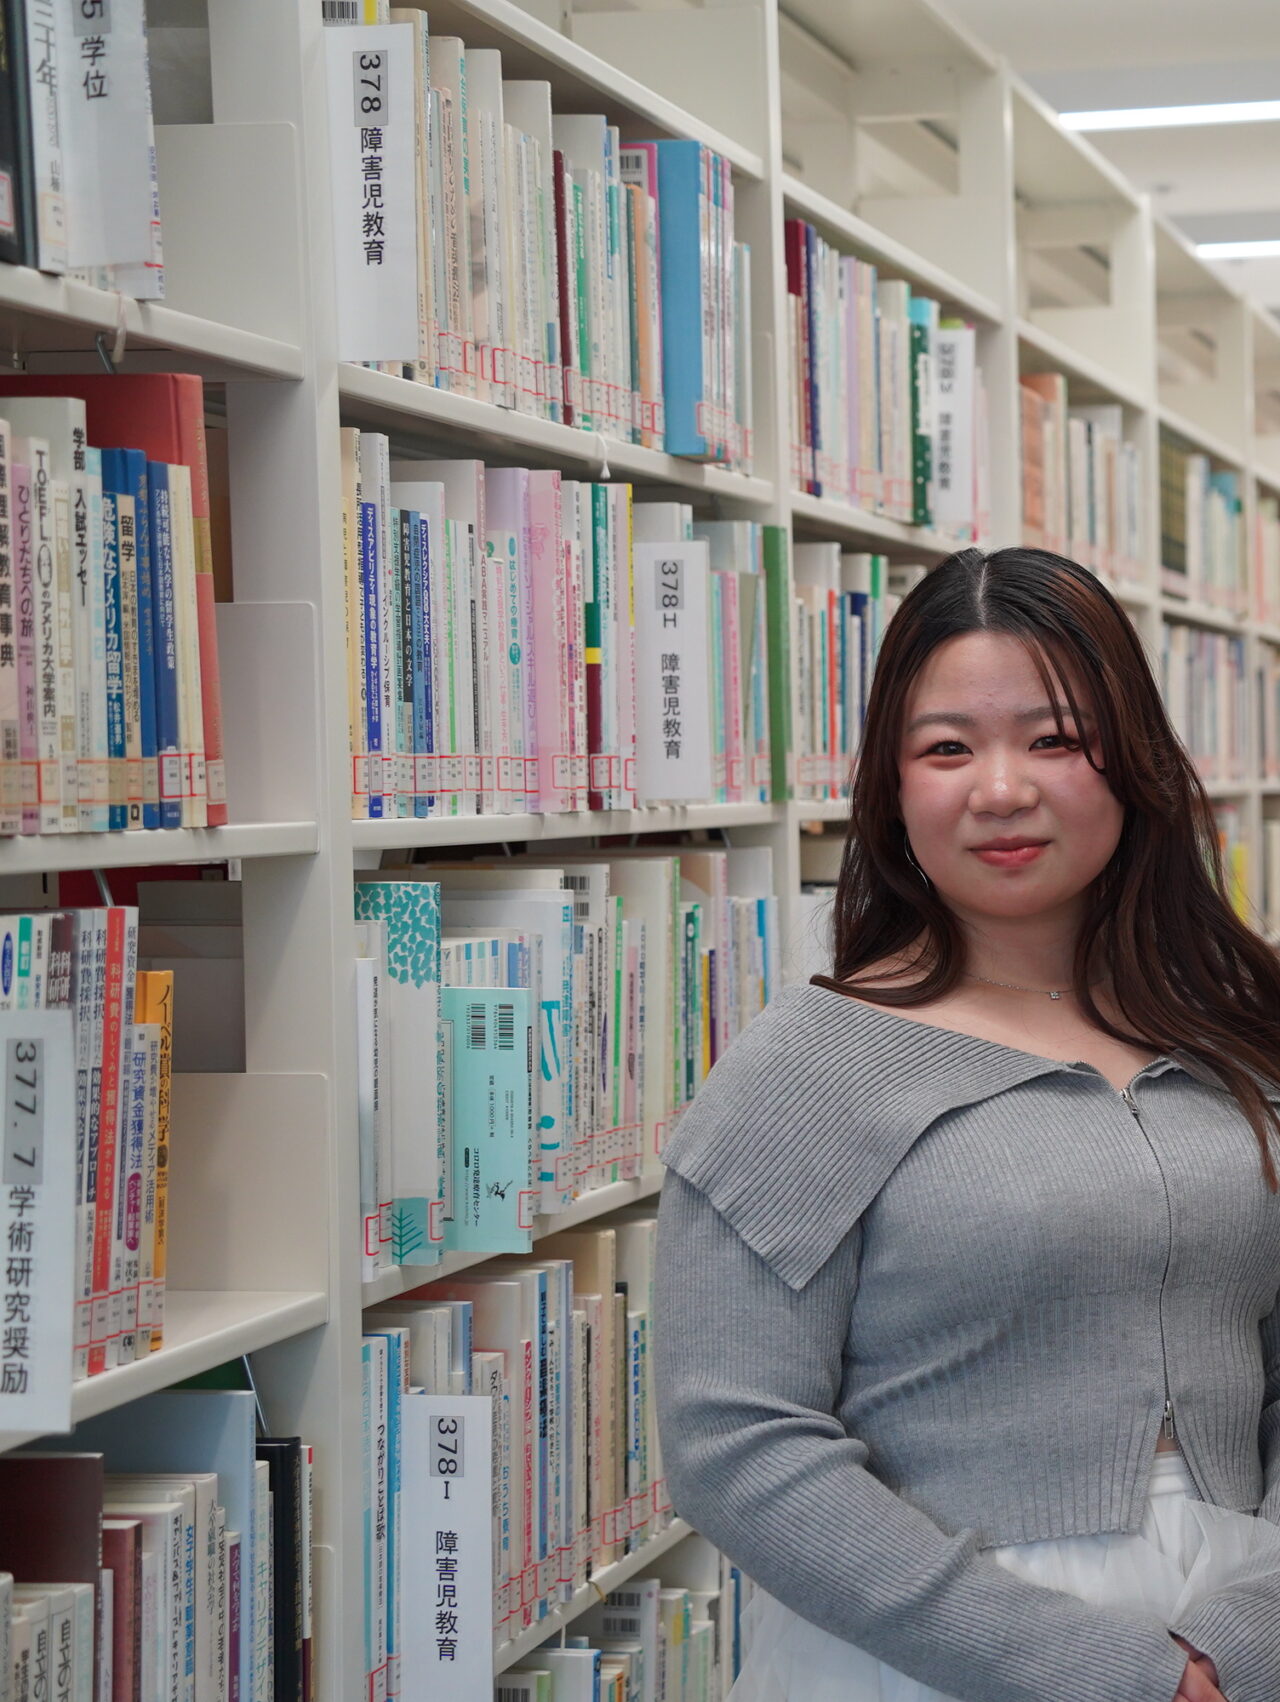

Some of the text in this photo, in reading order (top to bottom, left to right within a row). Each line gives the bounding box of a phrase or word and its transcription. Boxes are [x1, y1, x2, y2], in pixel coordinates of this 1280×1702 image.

[80, 37, 108, 100] 学位
[359, 53, 385, 266] 378 障害児教育
[75, 488, 88, 607] 入試エッセー
[101, 495, 124, 699] 危険なアメリカ留学
[121, 515, 135, 562] 留学
[661, 562, 683, 760] 378H 障害児教育
[0, 1041, 37, 1394] 377.7 学術研究奨励
[435, 1418, 459, 1661] 378I 障害児教育
